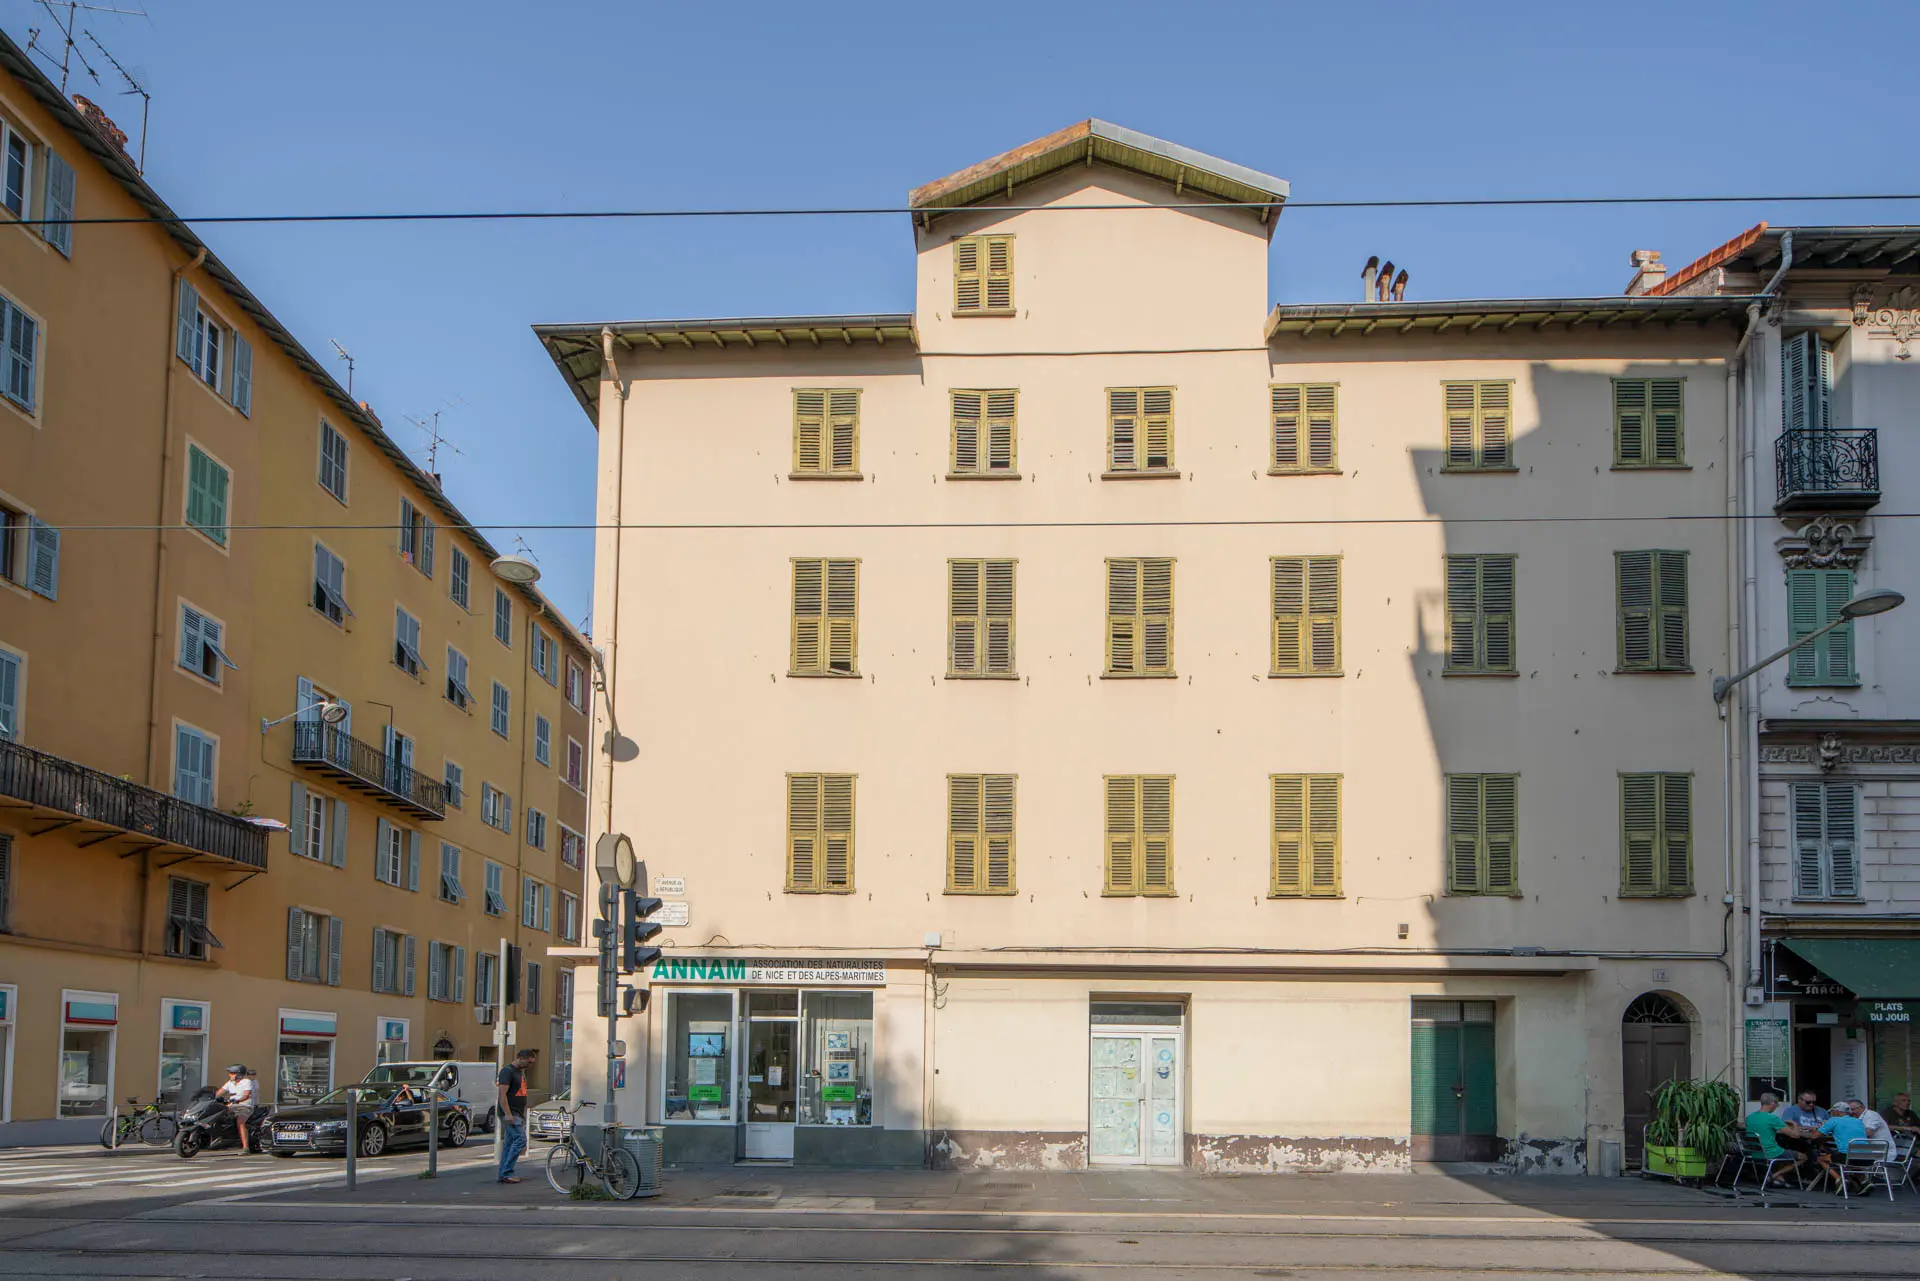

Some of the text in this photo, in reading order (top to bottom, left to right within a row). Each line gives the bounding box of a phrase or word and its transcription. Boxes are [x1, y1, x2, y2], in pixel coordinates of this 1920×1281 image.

[653, 959, 746, 979] ANNAM
[753, 959, 884, 969] ASSOCIATION DES NATURALISTES
[752, 970, 884, 981] DE NICE ET DES ALPES-MARITIMES
[1874, 1002, 1904, 1011] PLATS
[1870, 1013, 1910, 1021] DU JOUR
